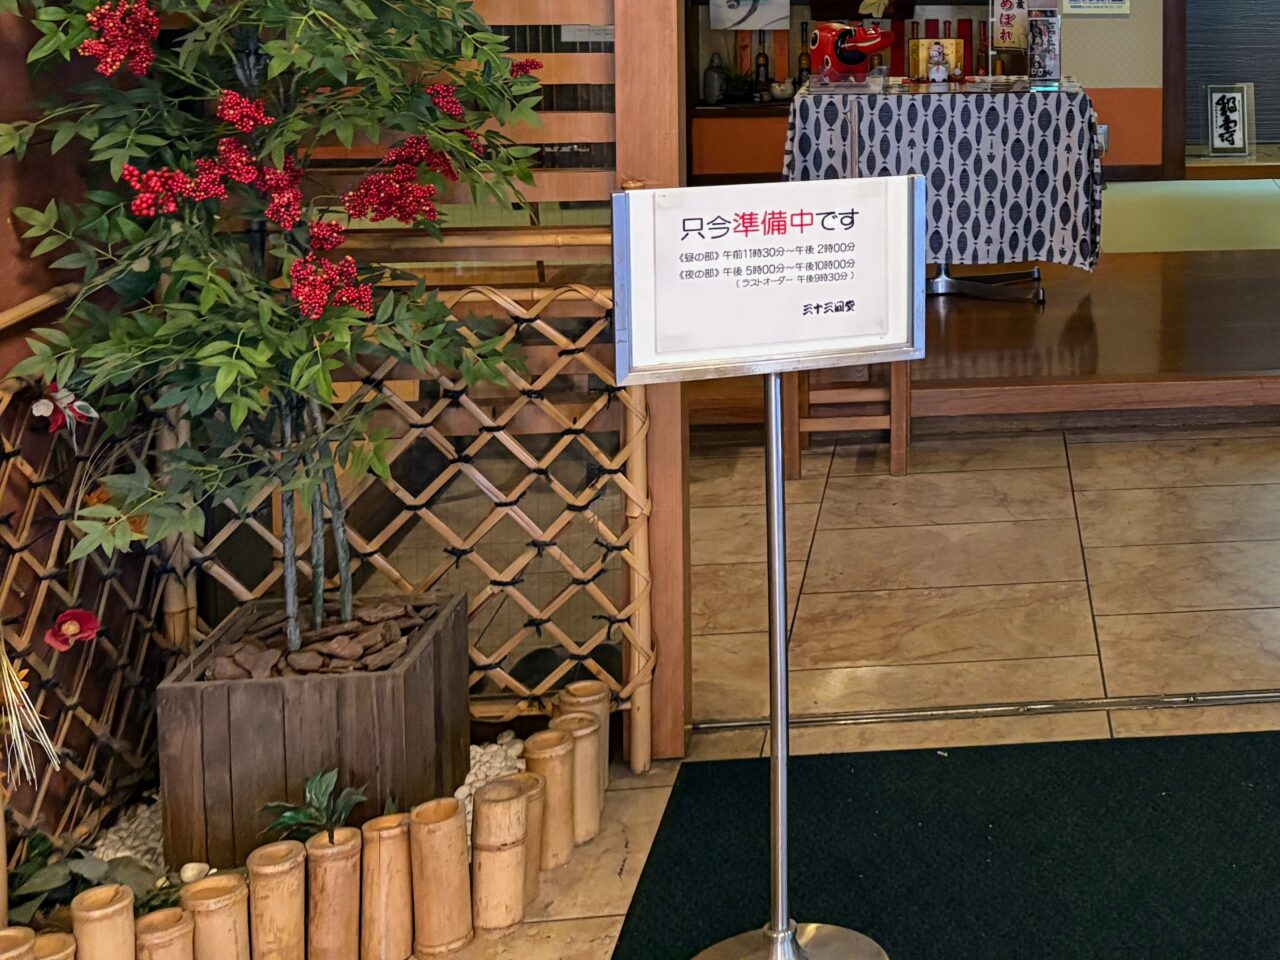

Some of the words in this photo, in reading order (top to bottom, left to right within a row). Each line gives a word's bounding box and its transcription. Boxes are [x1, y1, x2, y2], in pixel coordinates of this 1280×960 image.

[680, 208, 860, 241] 只今準備中です
[678, 250, 720, 263] 《昼の部》
[678, 267, 720, 280] 《夜の部》
